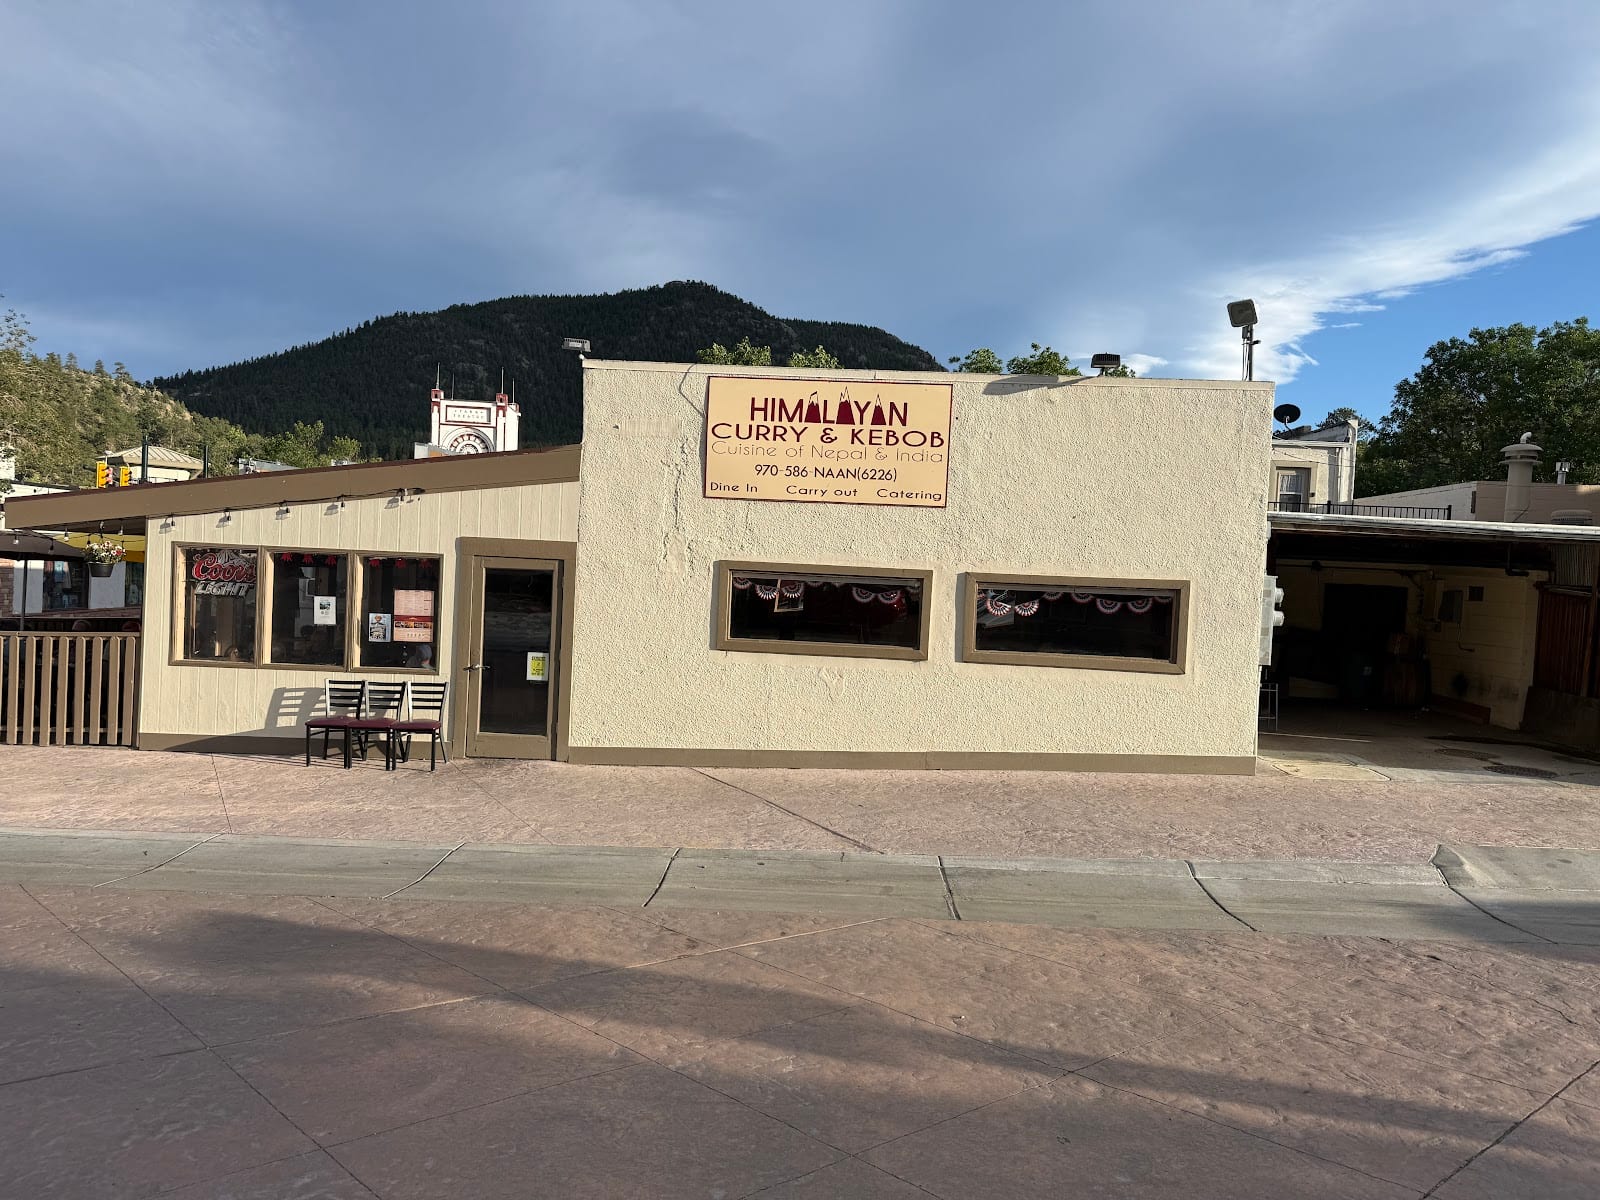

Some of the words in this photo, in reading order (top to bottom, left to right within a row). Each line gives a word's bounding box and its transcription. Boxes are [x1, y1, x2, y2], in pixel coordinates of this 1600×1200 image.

[750, 386, 909, 426] HIMALAYAN
[711, 422, 808, 443] CURRY
[820, 427, 838, 444] &
[850, 428, 945, 448] KEBOB
[711, 441, 777, 457] Cuisine
[785, 445, 805, 458] of
[811, 445, 867, 462] Nepal
[875, 447, 888, 461] &
[896, 449, 943, 463] India
[710, 481, 740, 492] Dine
[746, 483, 758, 493] In
[786, 485, 828, 498] Carry
[834, 488, 858, 498] out
[876, 488, 942, 501] Catering
[192, 553, 256, 582] Coors
[195, 581, 249, 596] LIGHT
